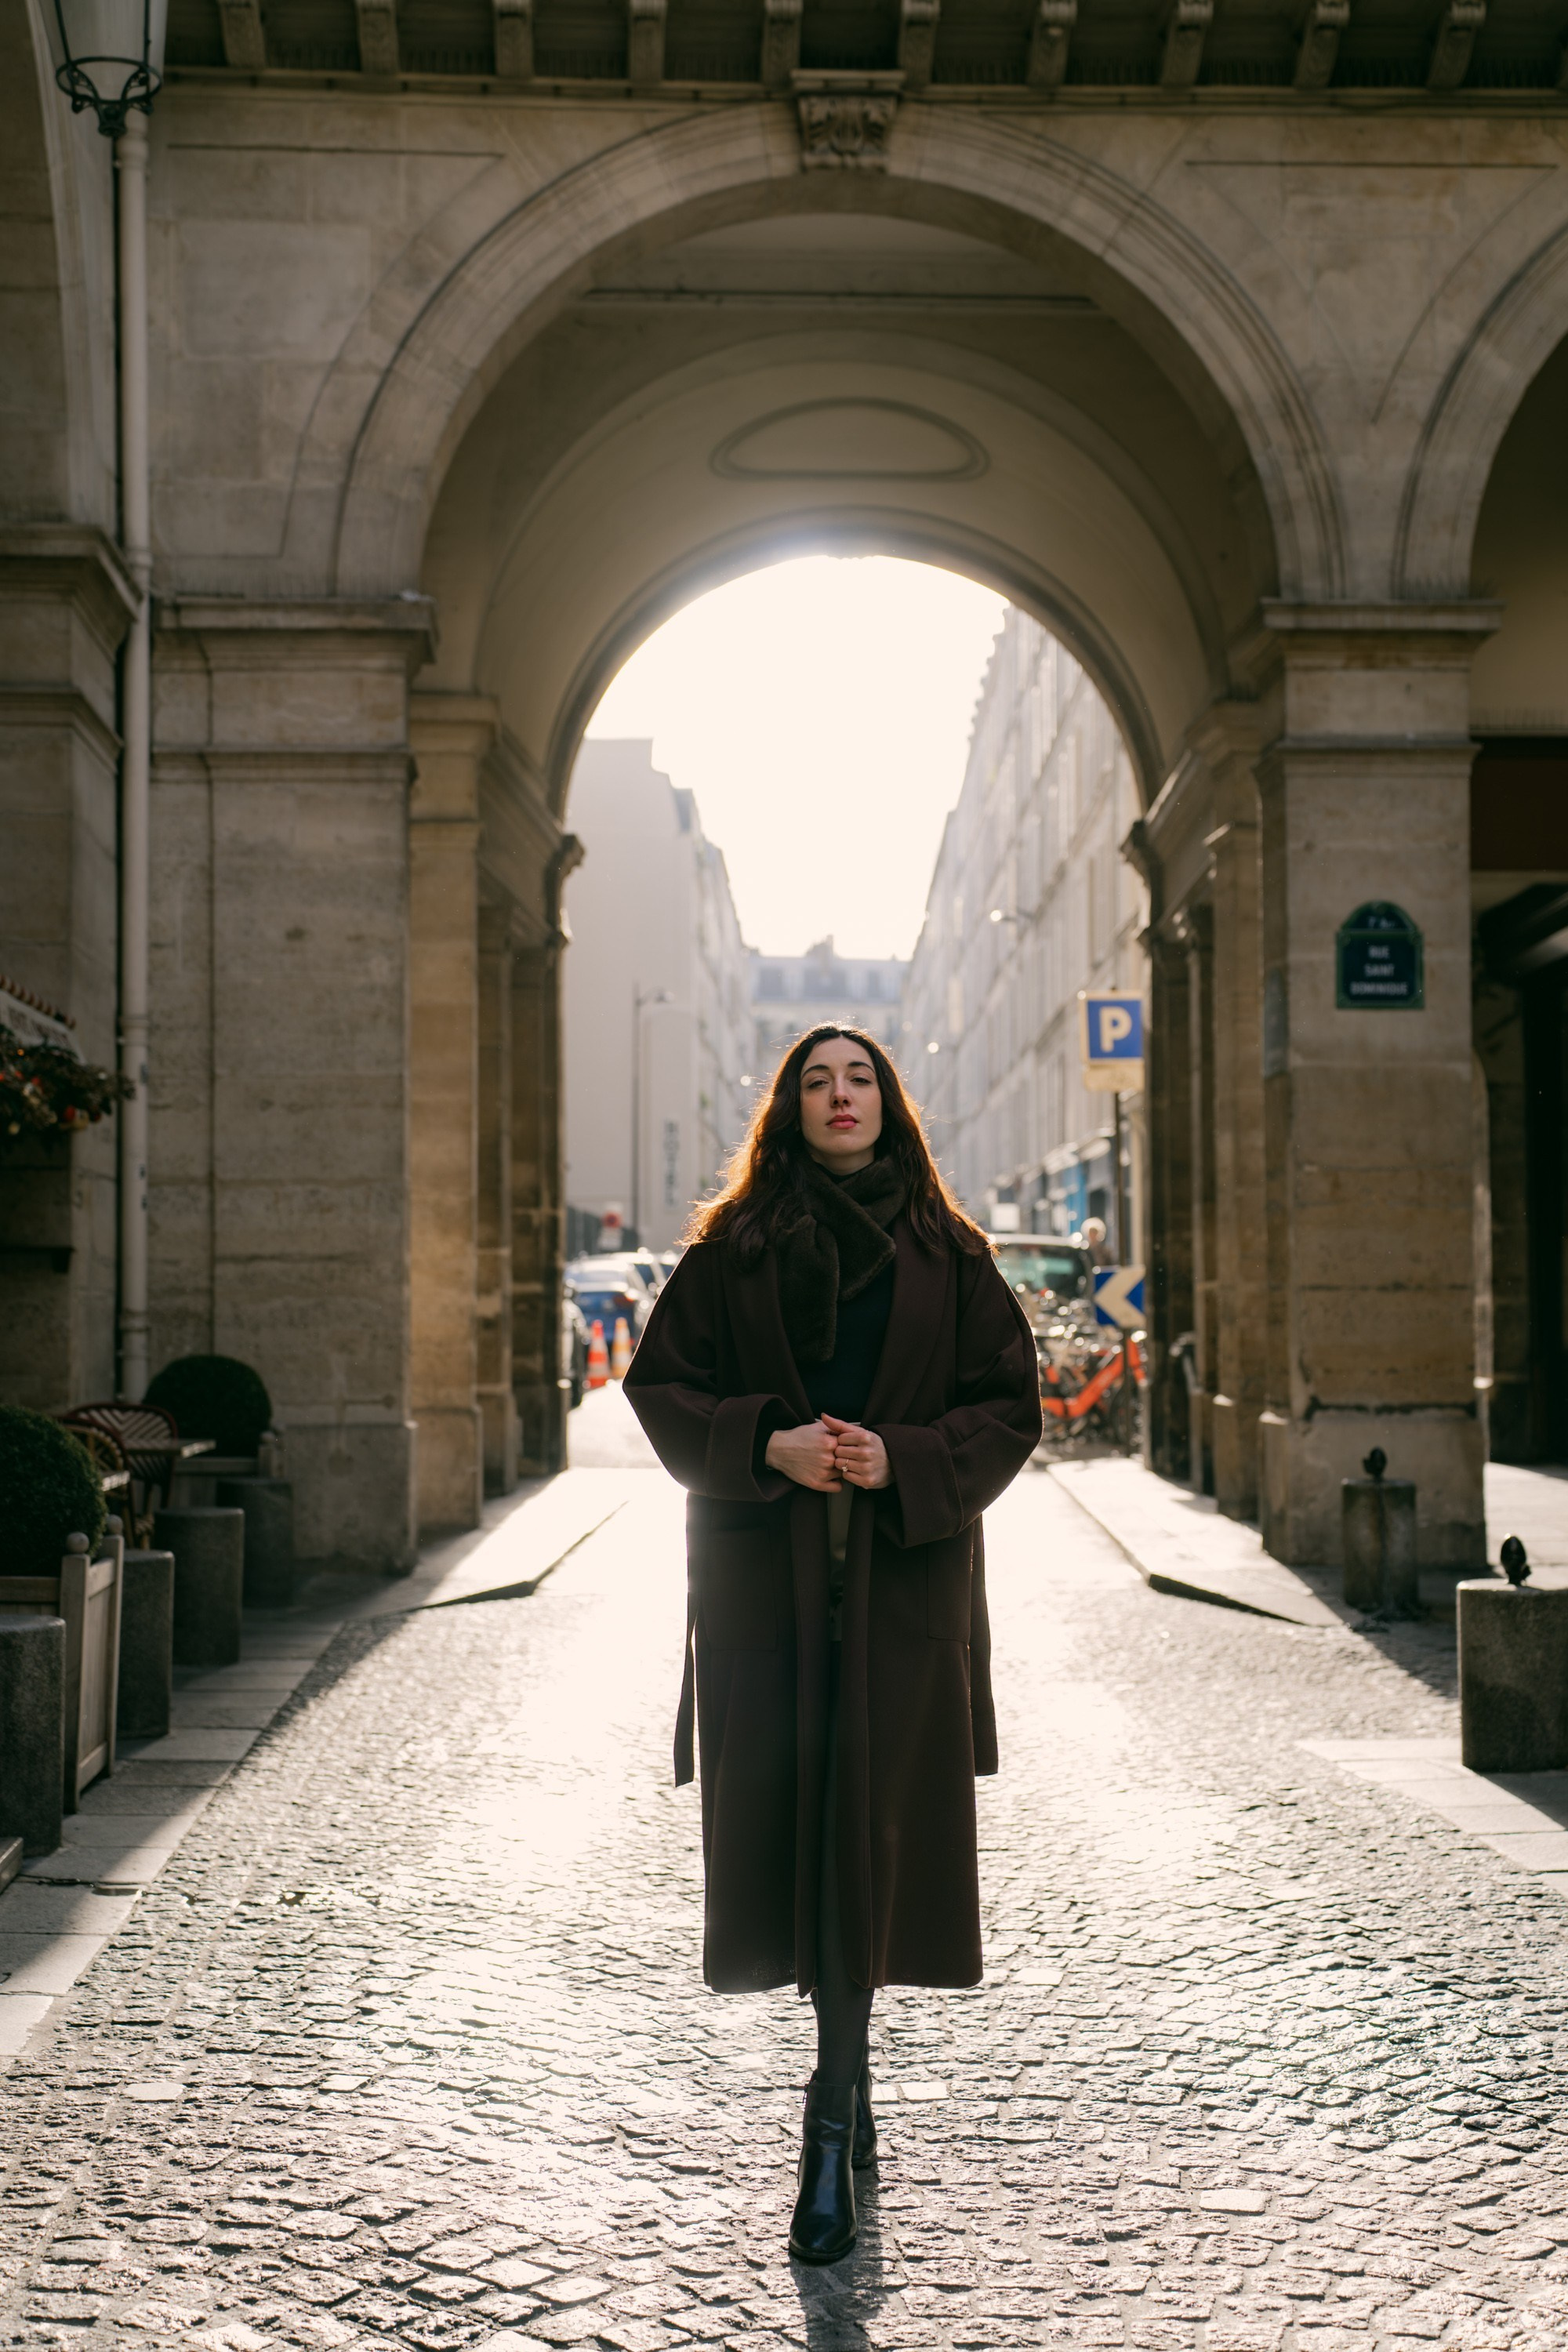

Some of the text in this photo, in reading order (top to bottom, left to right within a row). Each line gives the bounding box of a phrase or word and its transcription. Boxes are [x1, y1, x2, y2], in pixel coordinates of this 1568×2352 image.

[1369, 946, 1389, 958] RUE
[1364, 964, 1395, 976] SAINT
[1350, 982, 1407, 994] DOMINIQUE
[1100, 1006, 1132, 1052] P
